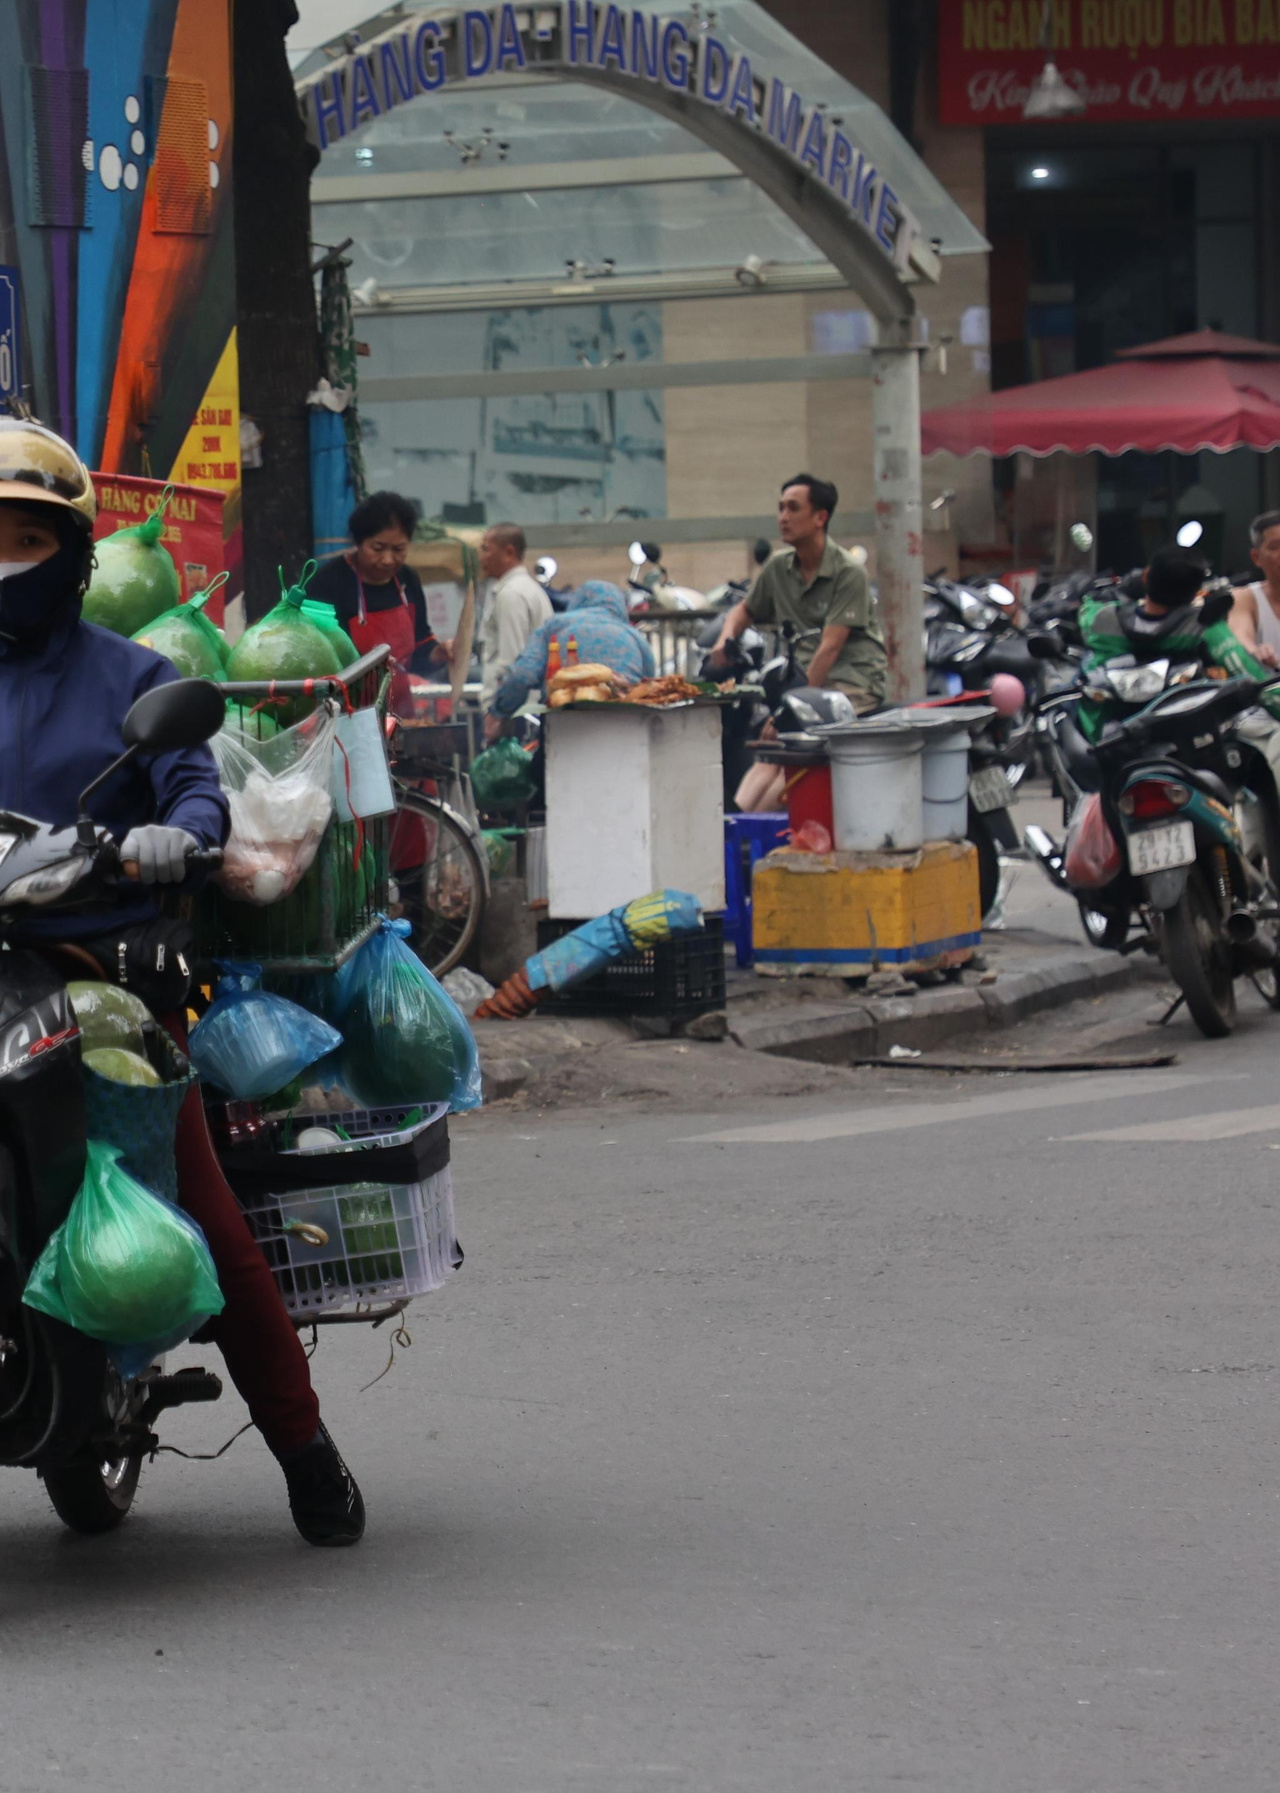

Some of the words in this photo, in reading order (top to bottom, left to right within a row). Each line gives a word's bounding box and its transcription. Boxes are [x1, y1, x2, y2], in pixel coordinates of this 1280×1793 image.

[1174, 0, 1226, 46] BIA
[464, 3, 526, 78] DA
[569, 0, 690, 88] HANG
[704, 37, 756, 123] DA
[1193, 63, 1280, 105] Khác
[101, 484, 141, 514] HÀNG
